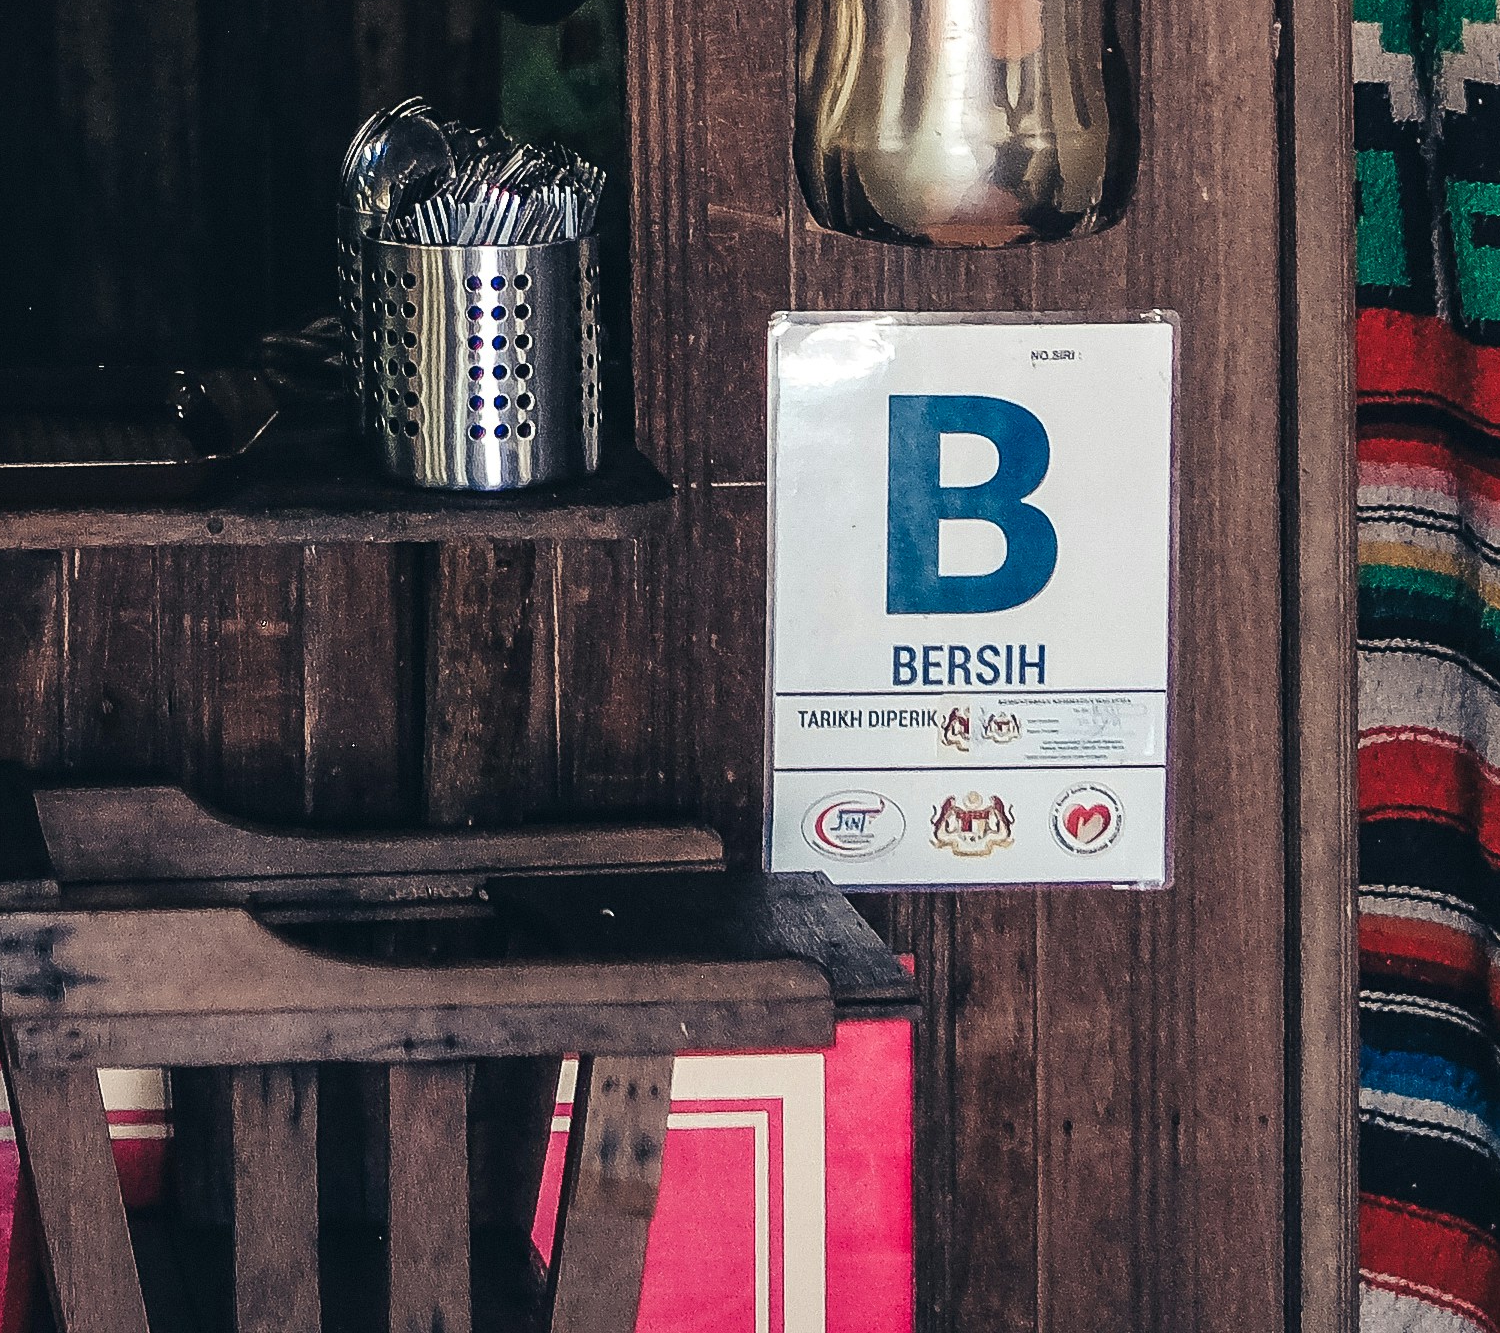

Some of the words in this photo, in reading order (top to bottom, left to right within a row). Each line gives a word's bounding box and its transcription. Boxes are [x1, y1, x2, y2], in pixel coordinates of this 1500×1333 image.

[886, 393, 1058, 616] B
[892, 644, 1046, 687] BERSIH
[797, 709, 863, 729] TARIKH
